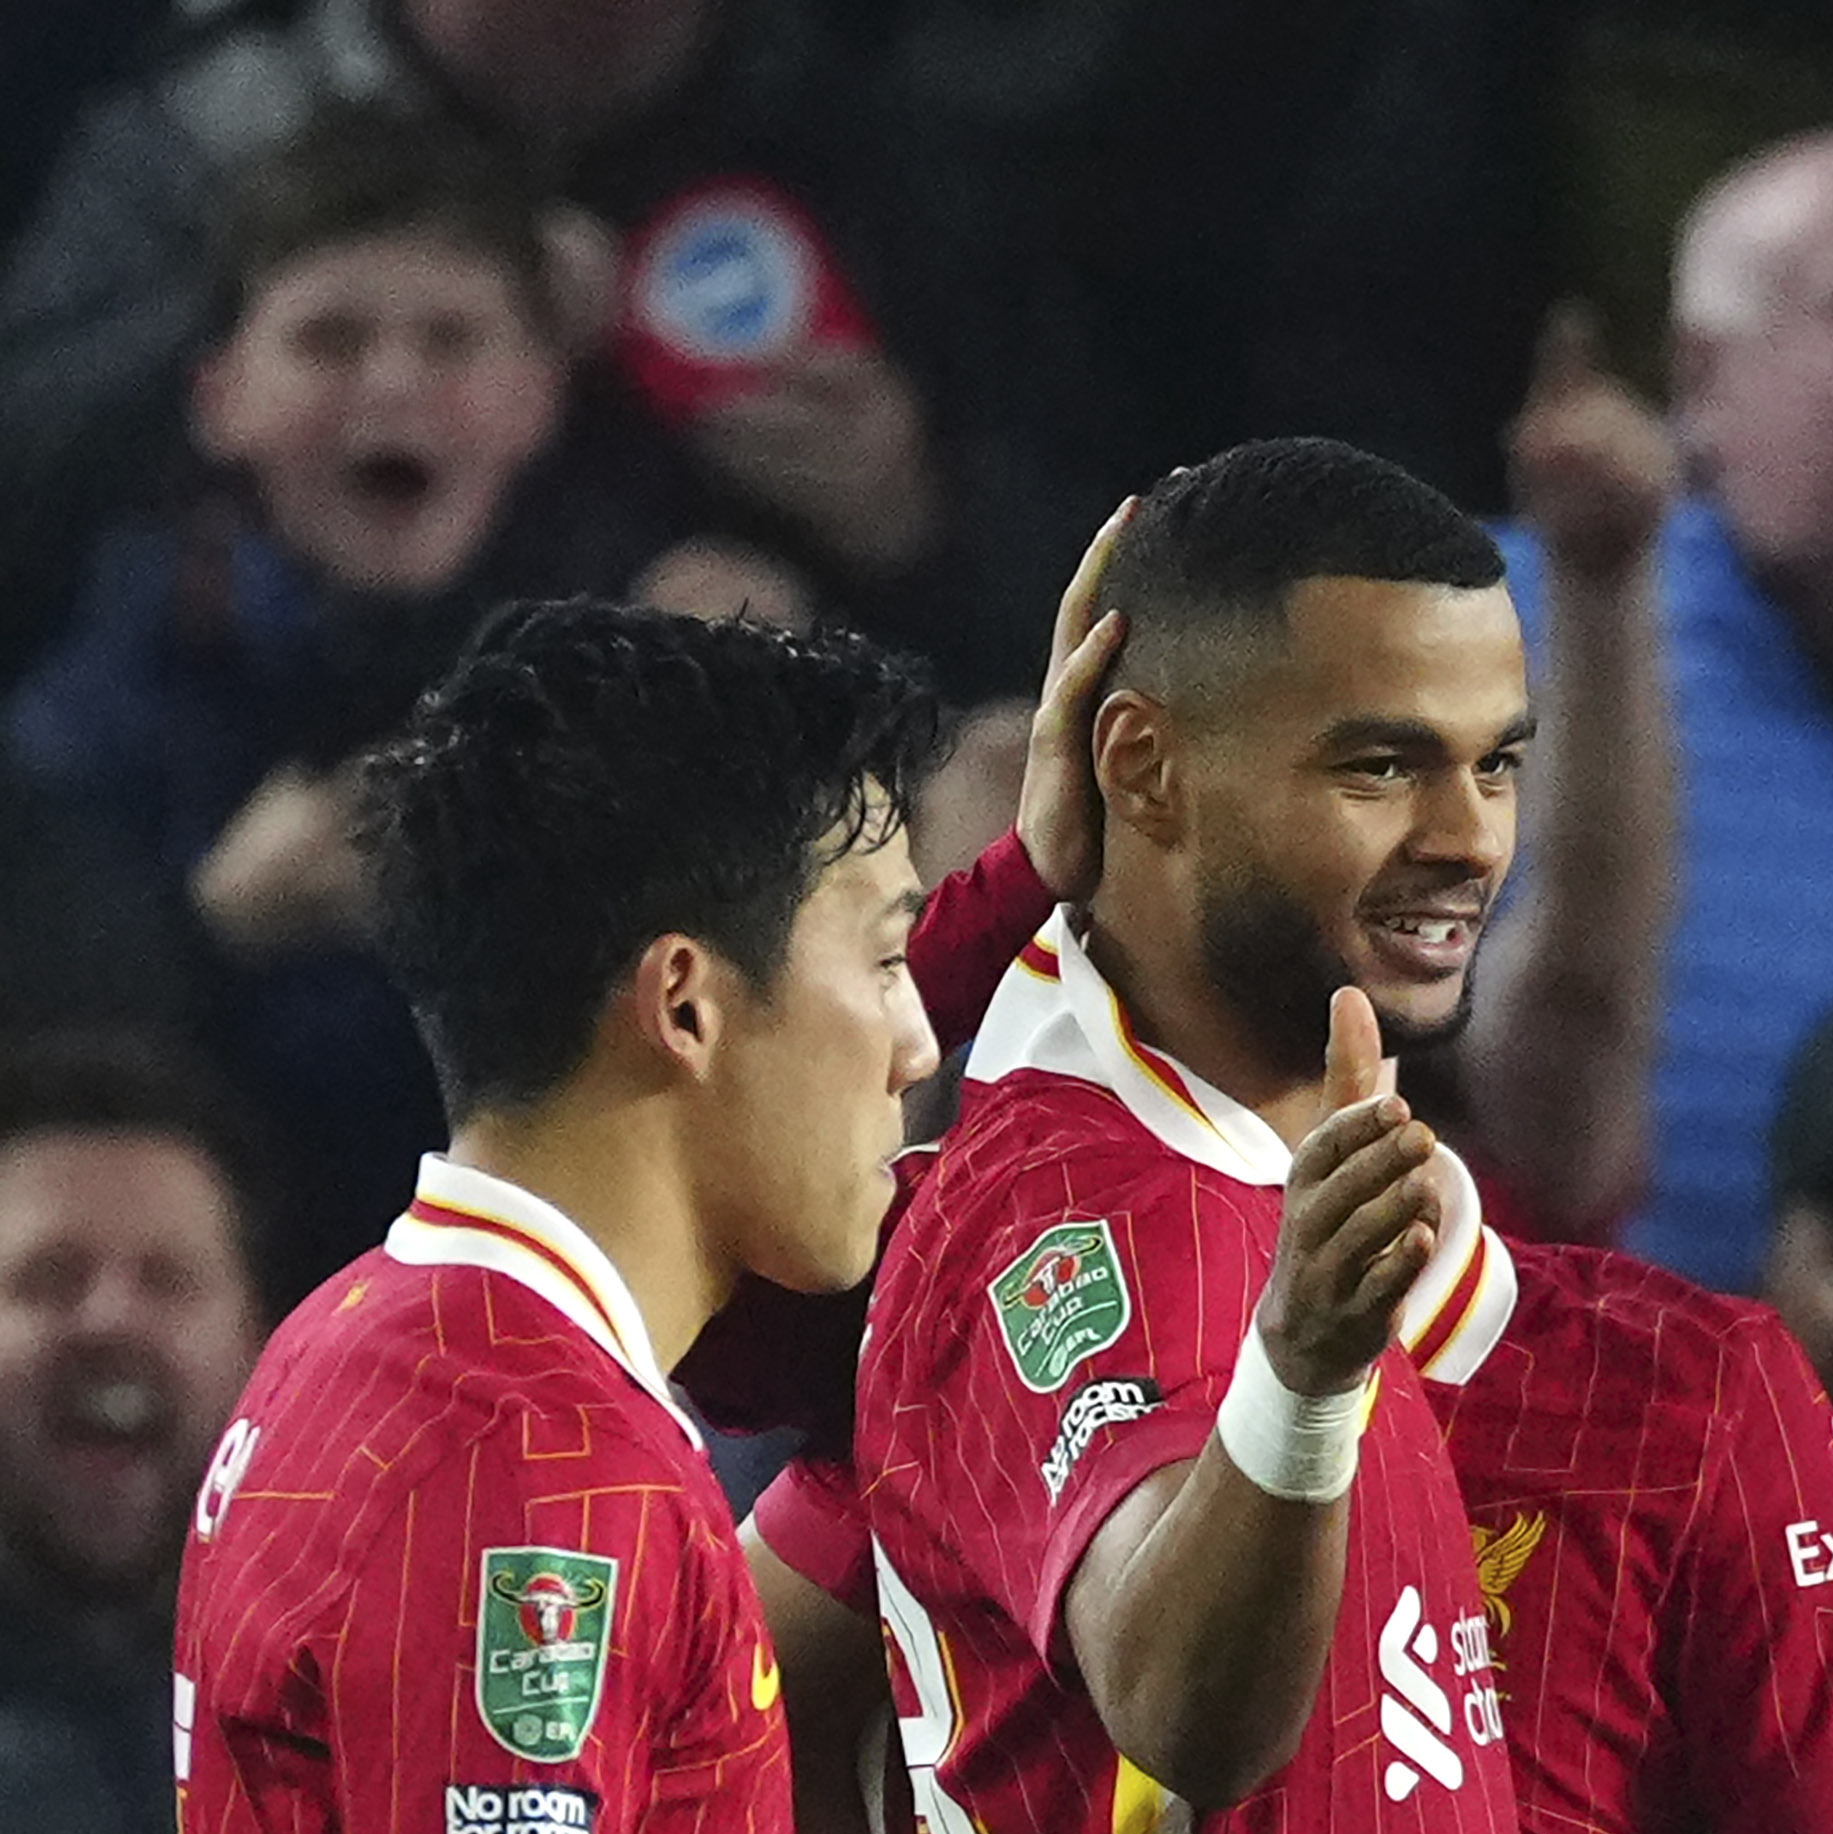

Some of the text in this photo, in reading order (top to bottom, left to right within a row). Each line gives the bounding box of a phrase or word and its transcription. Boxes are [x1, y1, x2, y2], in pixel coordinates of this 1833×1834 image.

[1061, 1382, 1145, 1438] room
[446, 1785, 586, 1825] No room
